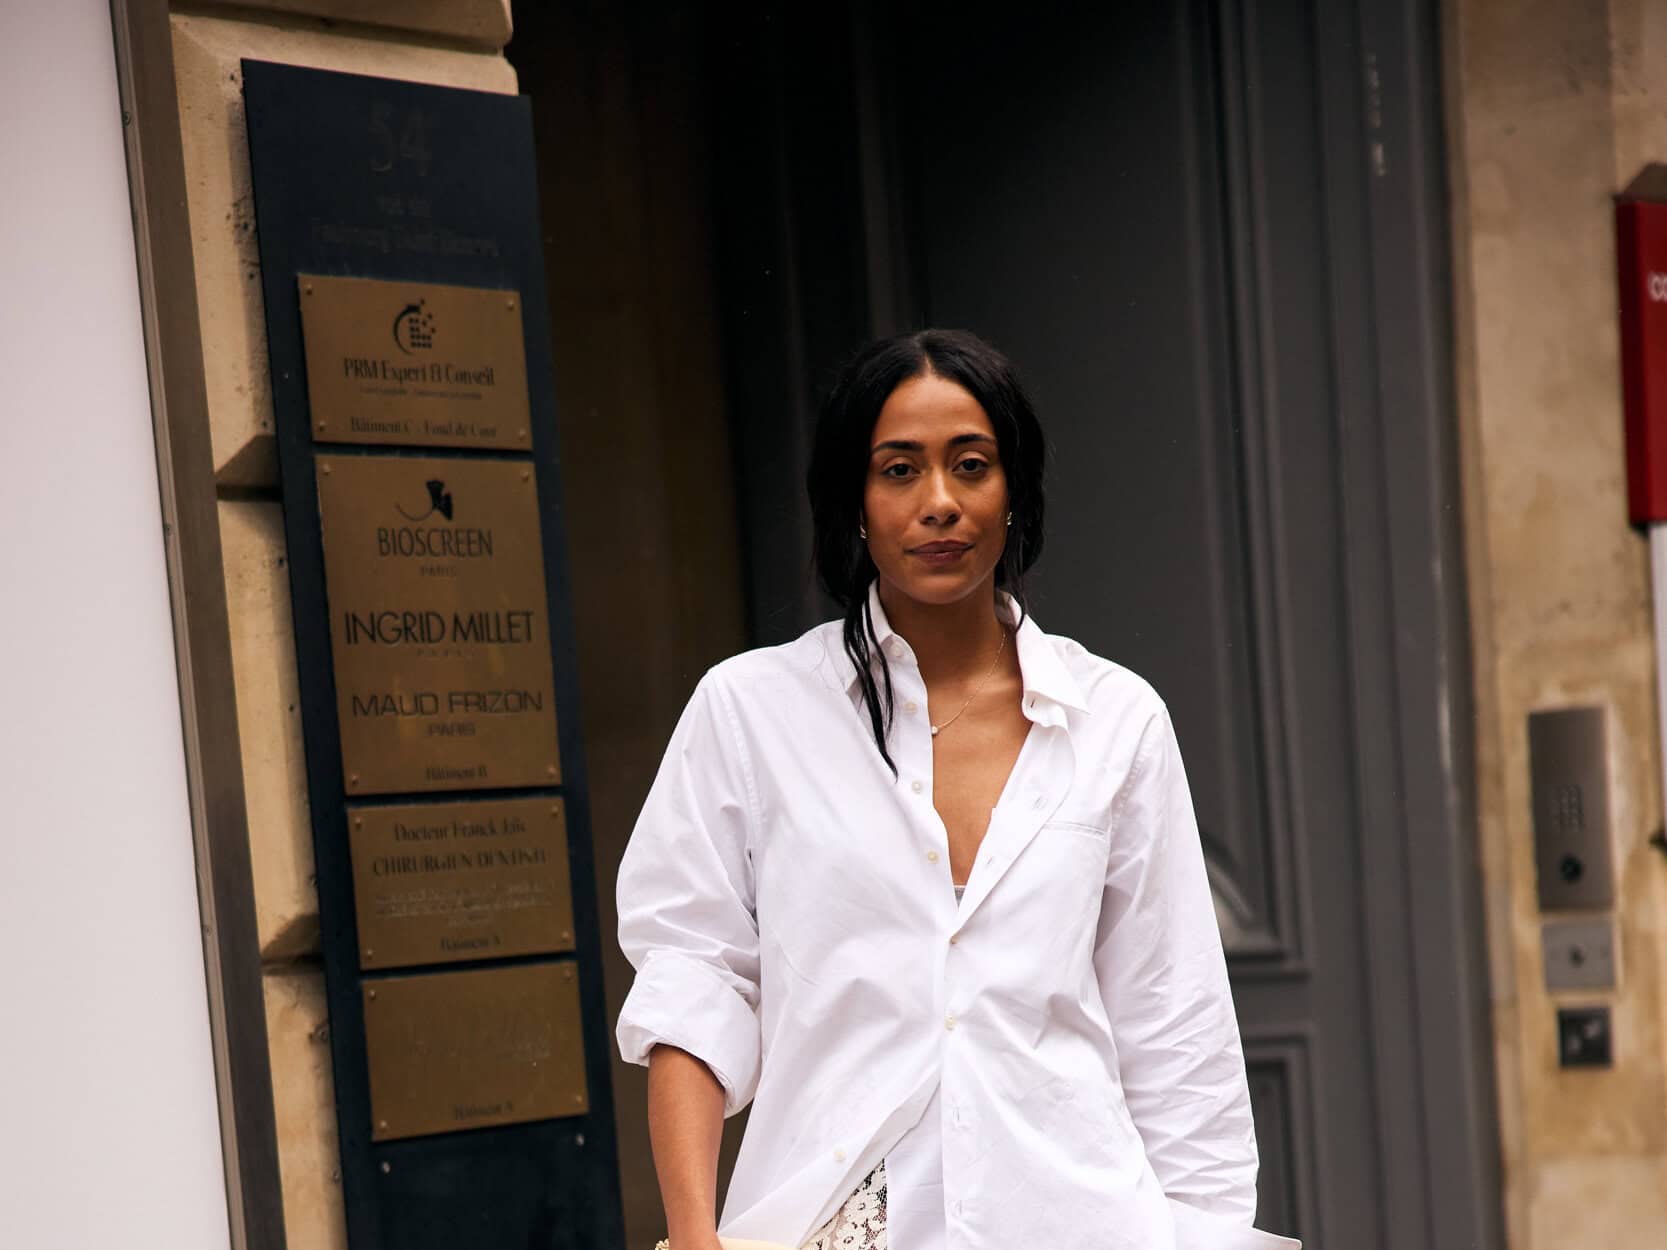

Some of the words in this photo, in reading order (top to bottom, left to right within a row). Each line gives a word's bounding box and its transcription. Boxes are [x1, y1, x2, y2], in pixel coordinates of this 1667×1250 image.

[343, 357, 378, 380] PRM
[381, 360, 427, 385] Expert
[446, 363, 496, 387] Conseil
[377, 526, 494, 558] BIOSCREEN
[344, 611, 446, 645] INGRID
[451, 610, 535, 645] MILLET
[352, 692, 440, 718] MAUD
[448, 689, 543, 714] FRIZON
[428, 722, 476, 737] PARIS
[394, 823, 448, 841] Docteur
